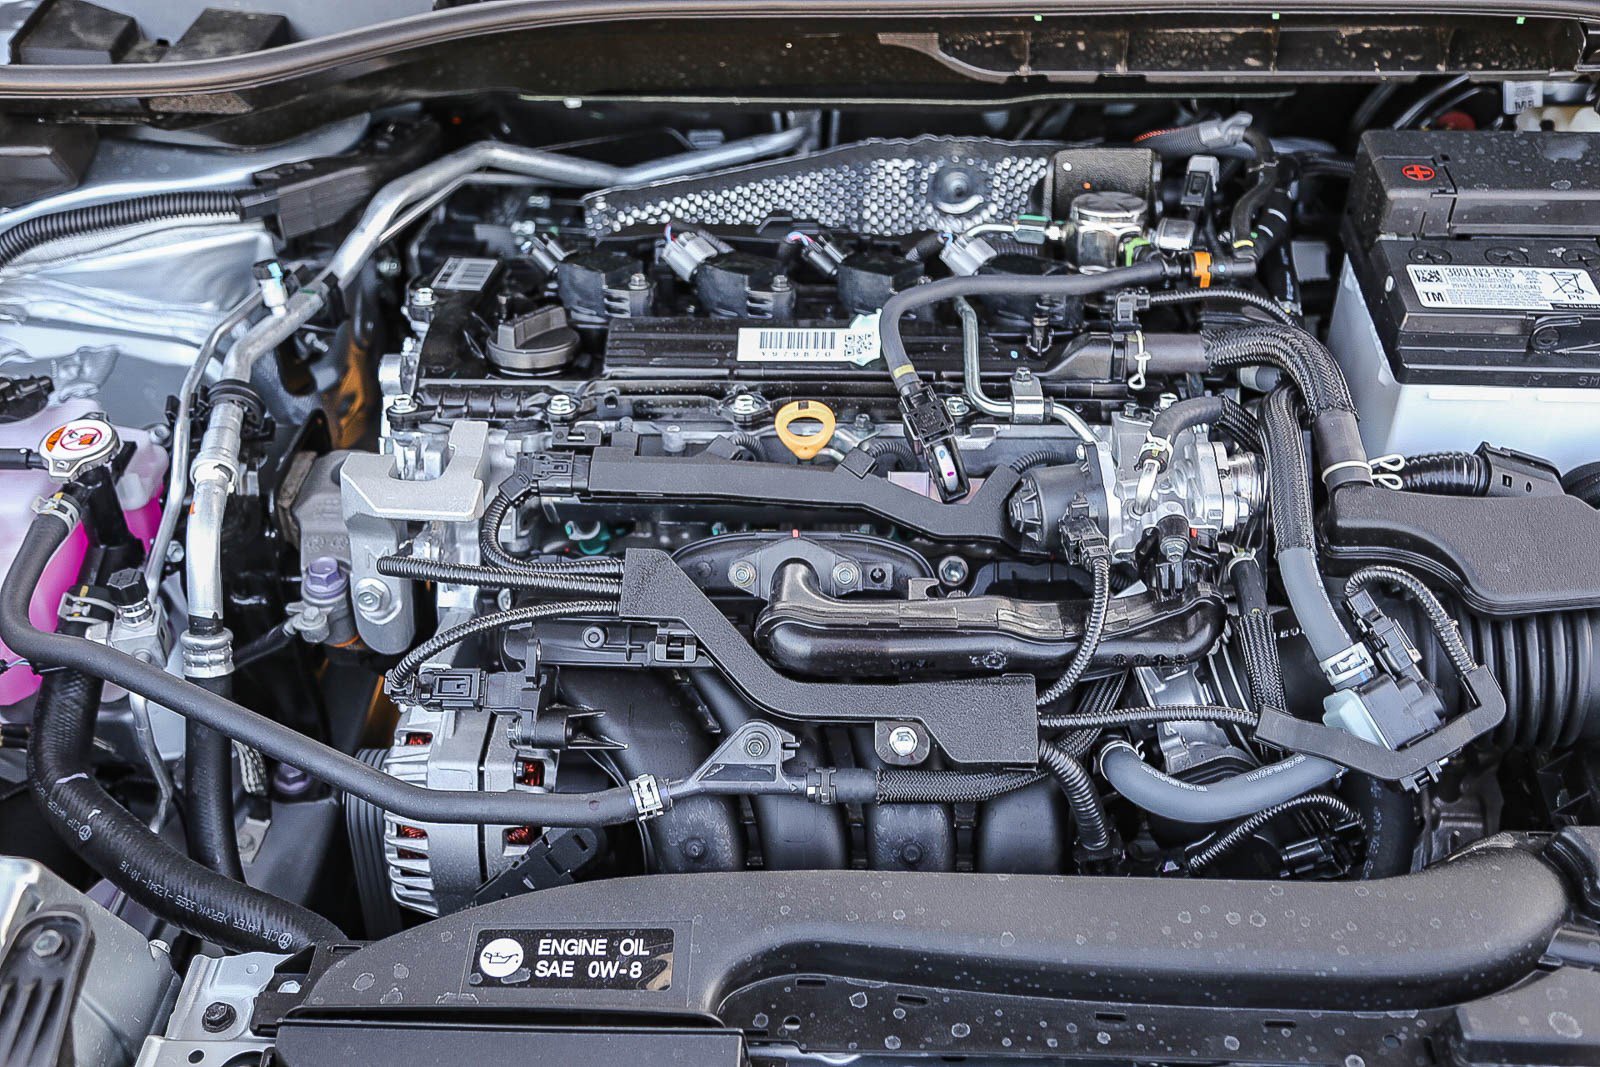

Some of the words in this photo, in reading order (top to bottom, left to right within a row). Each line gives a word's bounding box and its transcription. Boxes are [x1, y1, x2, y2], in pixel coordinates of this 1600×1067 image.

[1422, 291, 1445, 302] TM
[538, 939, 608, 956] ENGINE
[619, 938, 650, 956] OIL
[534, 960, 575, 978] SAE
[587, 961, 643, 979] 0W-8
